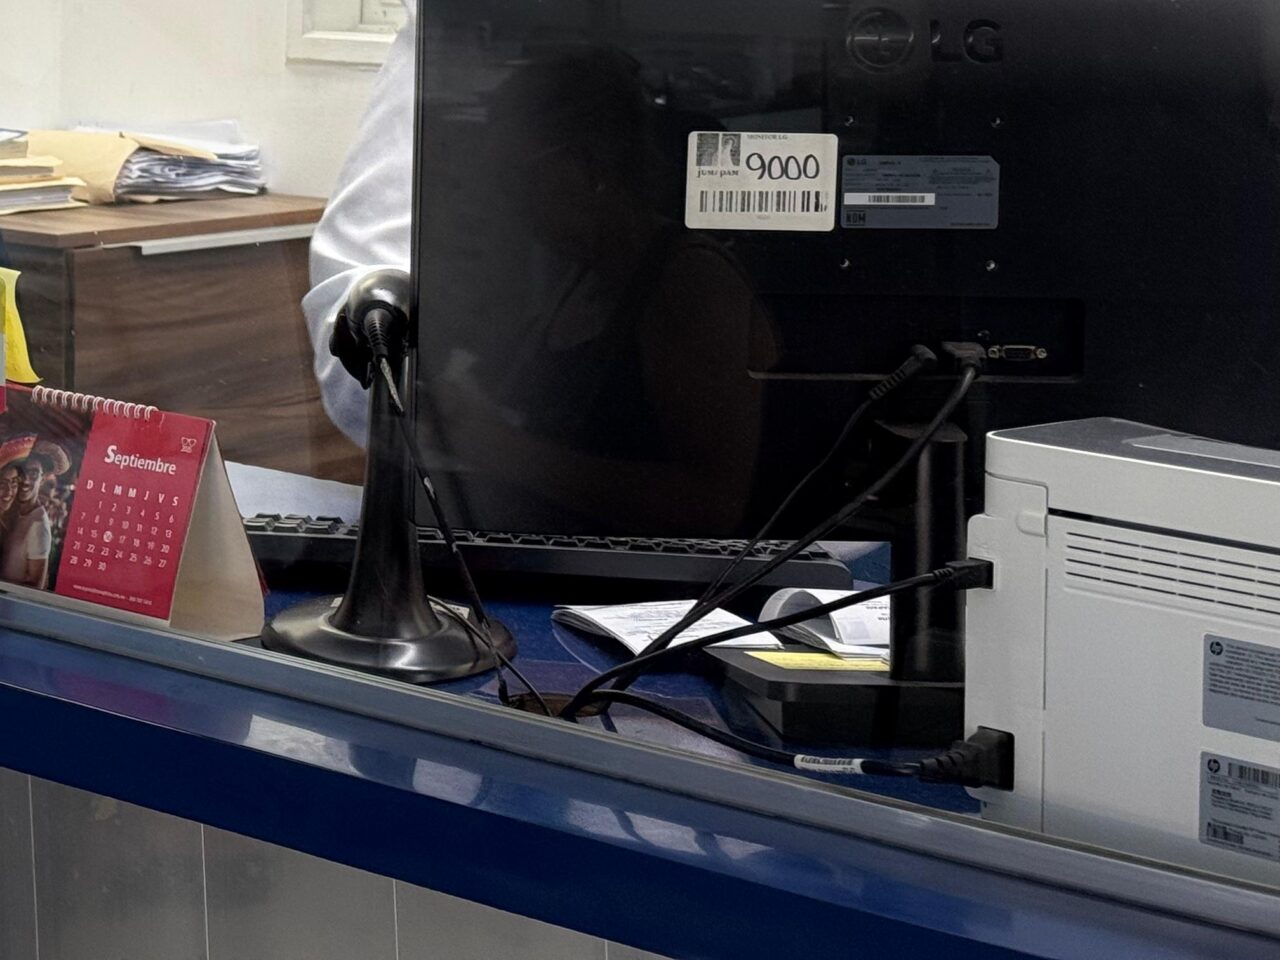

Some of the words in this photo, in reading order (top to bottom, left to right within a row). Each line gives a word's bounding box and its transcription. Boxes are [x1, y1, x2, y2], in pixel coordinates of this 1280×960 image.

[930, 19, 1003, 63] LG
[745, 152, 820, 180] 9000
[104, 444, 177, 475] Septiembre
[87, 480, 94, 489] D
[101, 482, 106, 492] L
[114, 485, 122, 495] M
[128, 488, 136, 498] M
[144, 490, 149, 500] J
[158, 493, 165, 503] V
[172, 496, 179, 506] S
